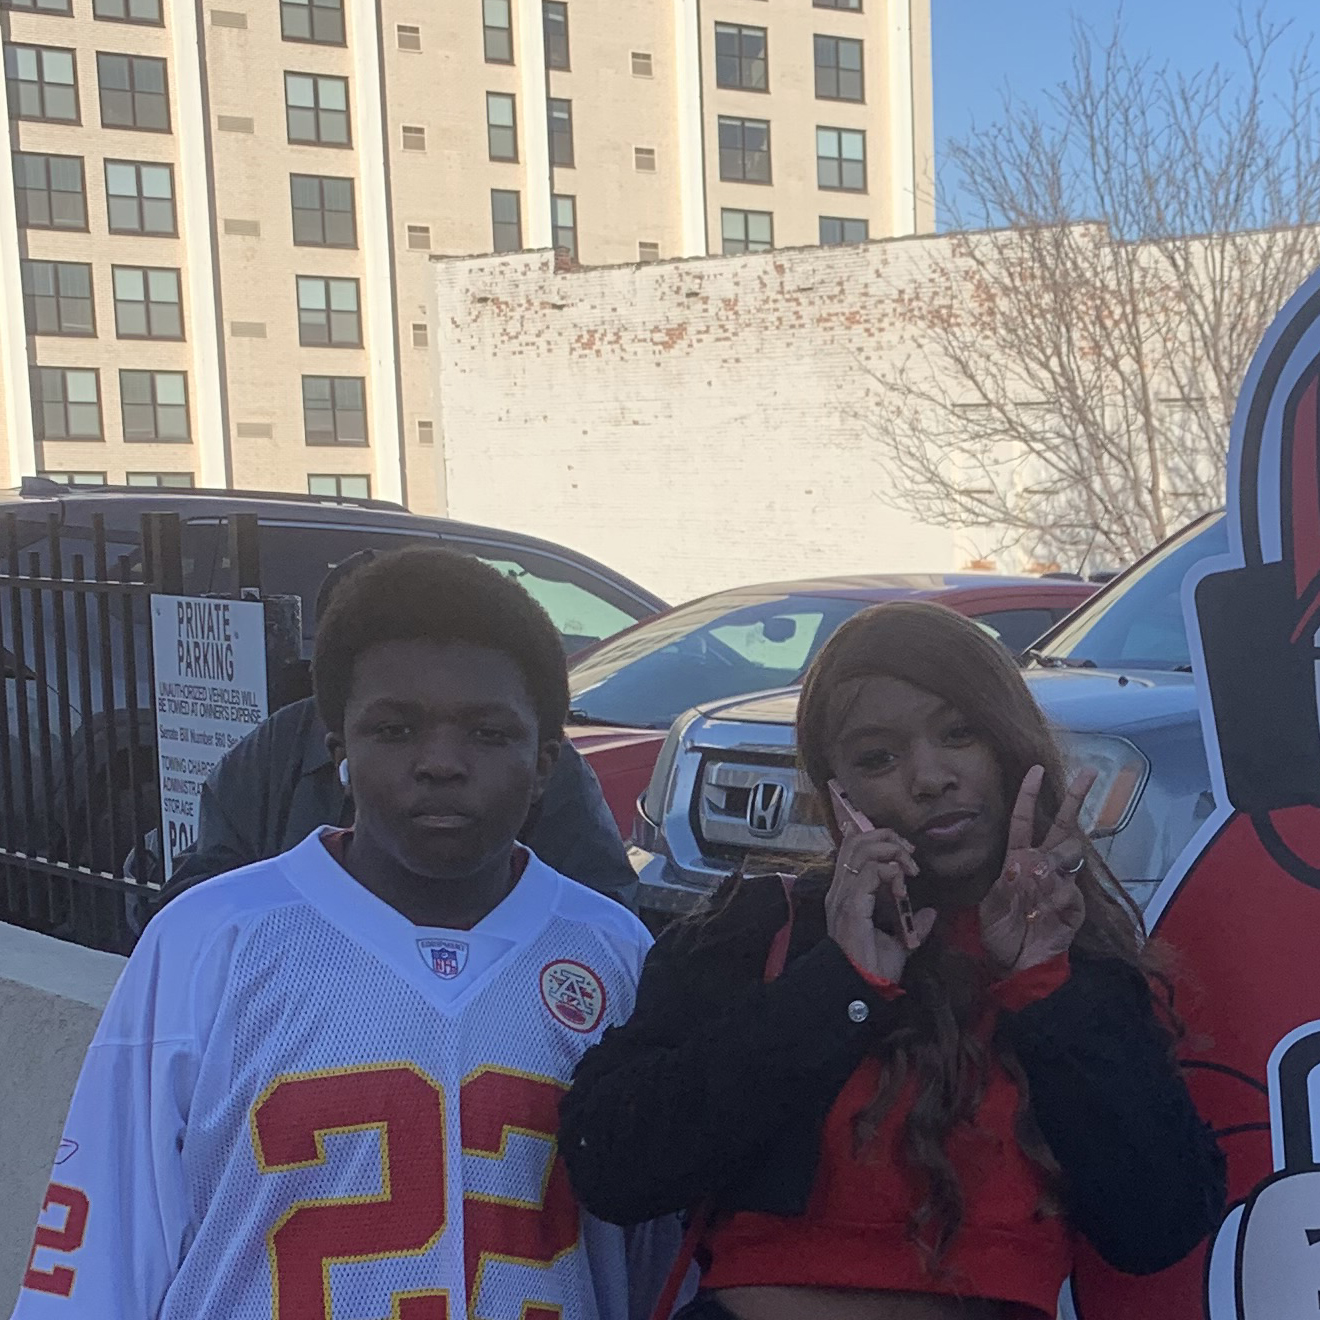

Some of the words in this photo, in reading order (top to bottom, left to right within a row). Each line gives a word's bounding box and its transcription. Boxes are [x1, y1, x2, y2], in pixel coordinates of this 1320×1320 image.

[177, 600, 231, 642] PRIVATE
[177, 640, 234, 682] PARKING
[159, 682, 207, 702] UNAUTHORIZED
[208, 687, 240, 705] VEHICLES
[240, 690, 258, 707] WILL
[167, 699, 190, 715] TOWED
[191, 702, 198, 717] AT
